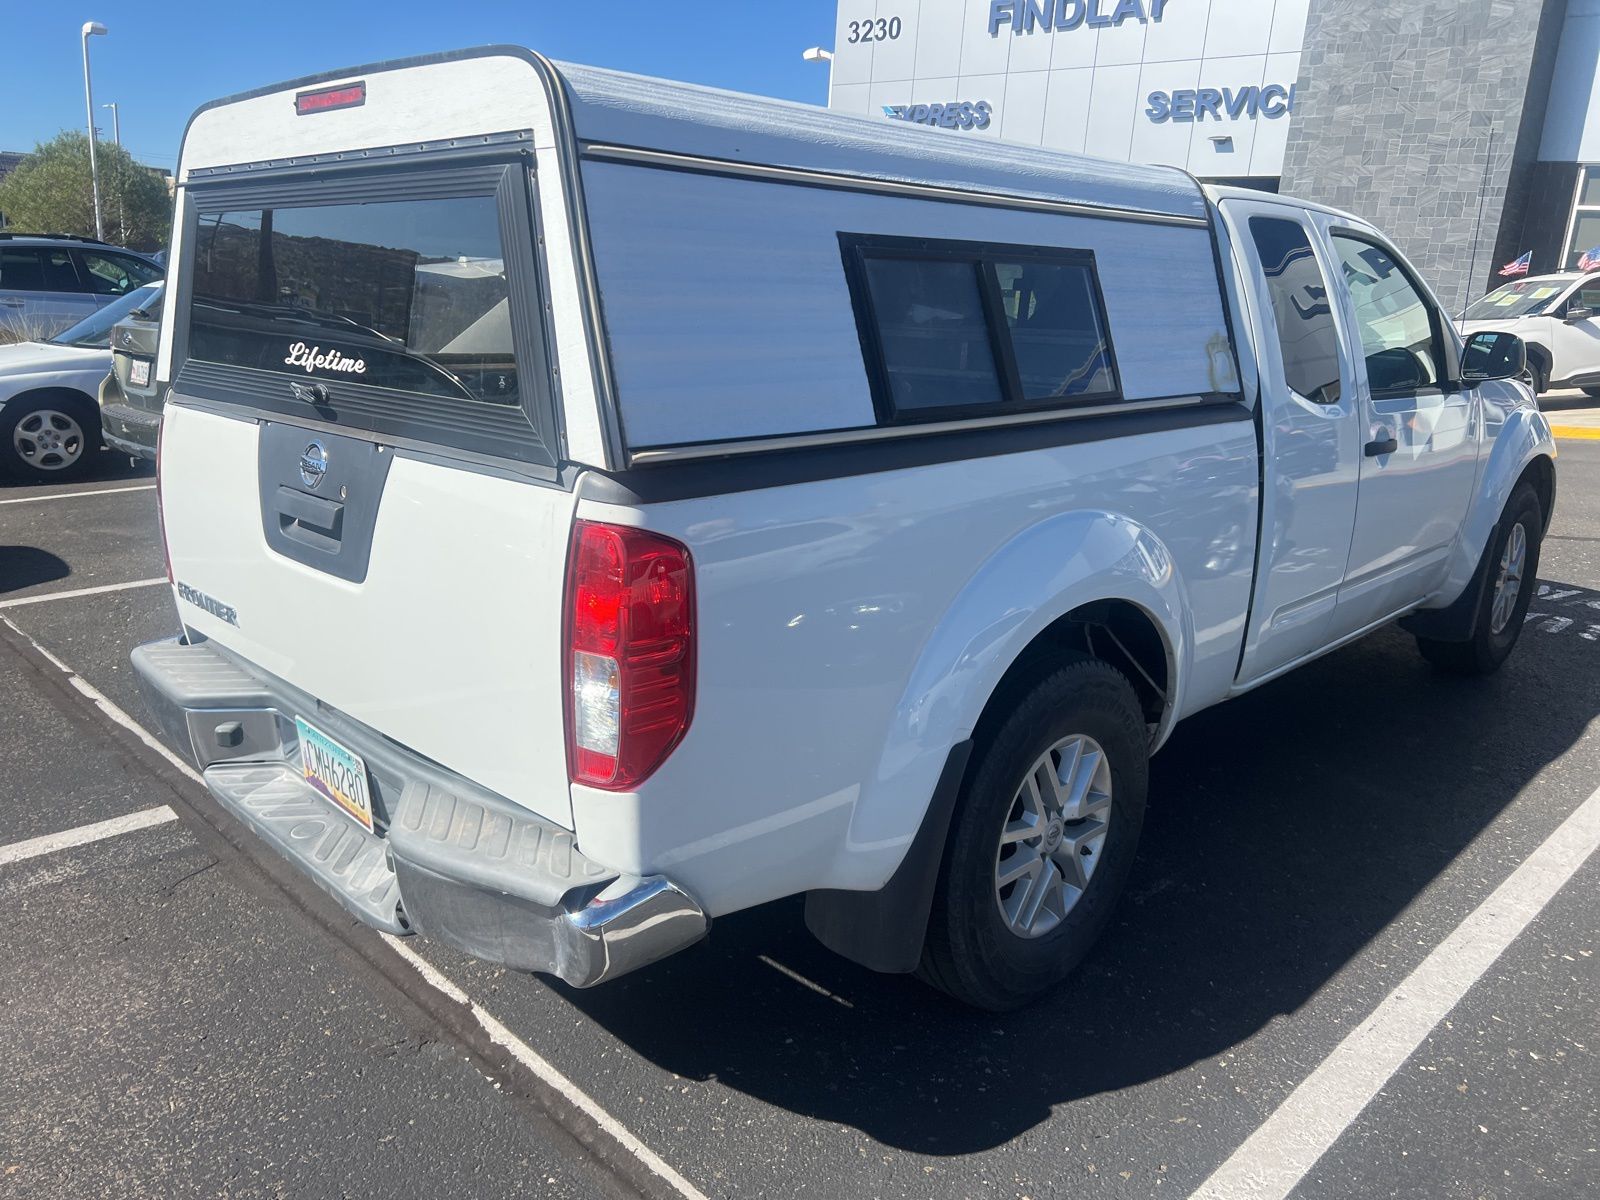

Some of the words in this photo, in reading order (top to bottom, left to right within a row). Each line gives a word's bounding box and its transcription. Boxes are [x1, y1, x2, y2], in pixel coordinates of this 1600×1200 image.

[848, 16, 902, 43] 3230
[988, 0, 1168, 38] FINDLAY
[284, 342, 366, 374] Lifetime
[306, 739, 365, 810] CMH6280
